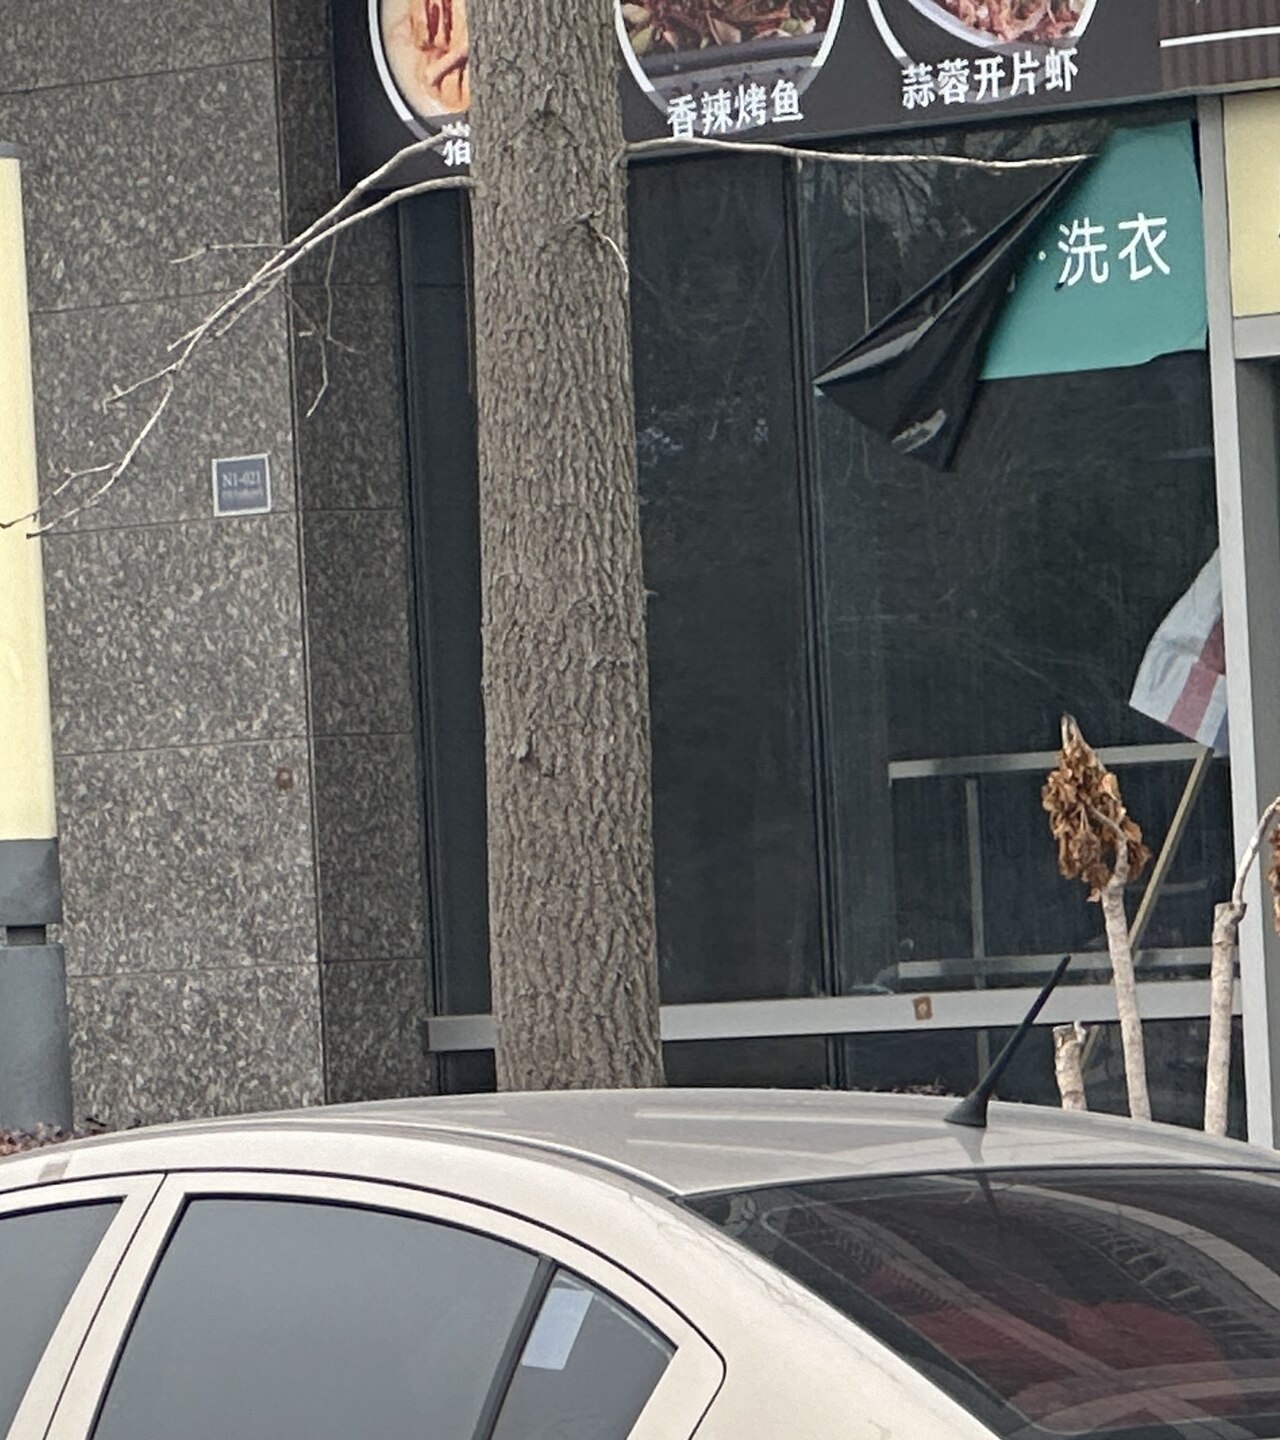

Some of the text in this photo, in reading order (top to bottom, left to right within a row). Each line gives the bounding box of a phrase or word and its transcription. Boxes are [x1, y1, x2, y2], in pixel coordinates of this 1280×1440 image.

[666, 79, 805, 139] 香辣烤鱼
[901, 47, 1079, 110] 蒜蓉开片虾
